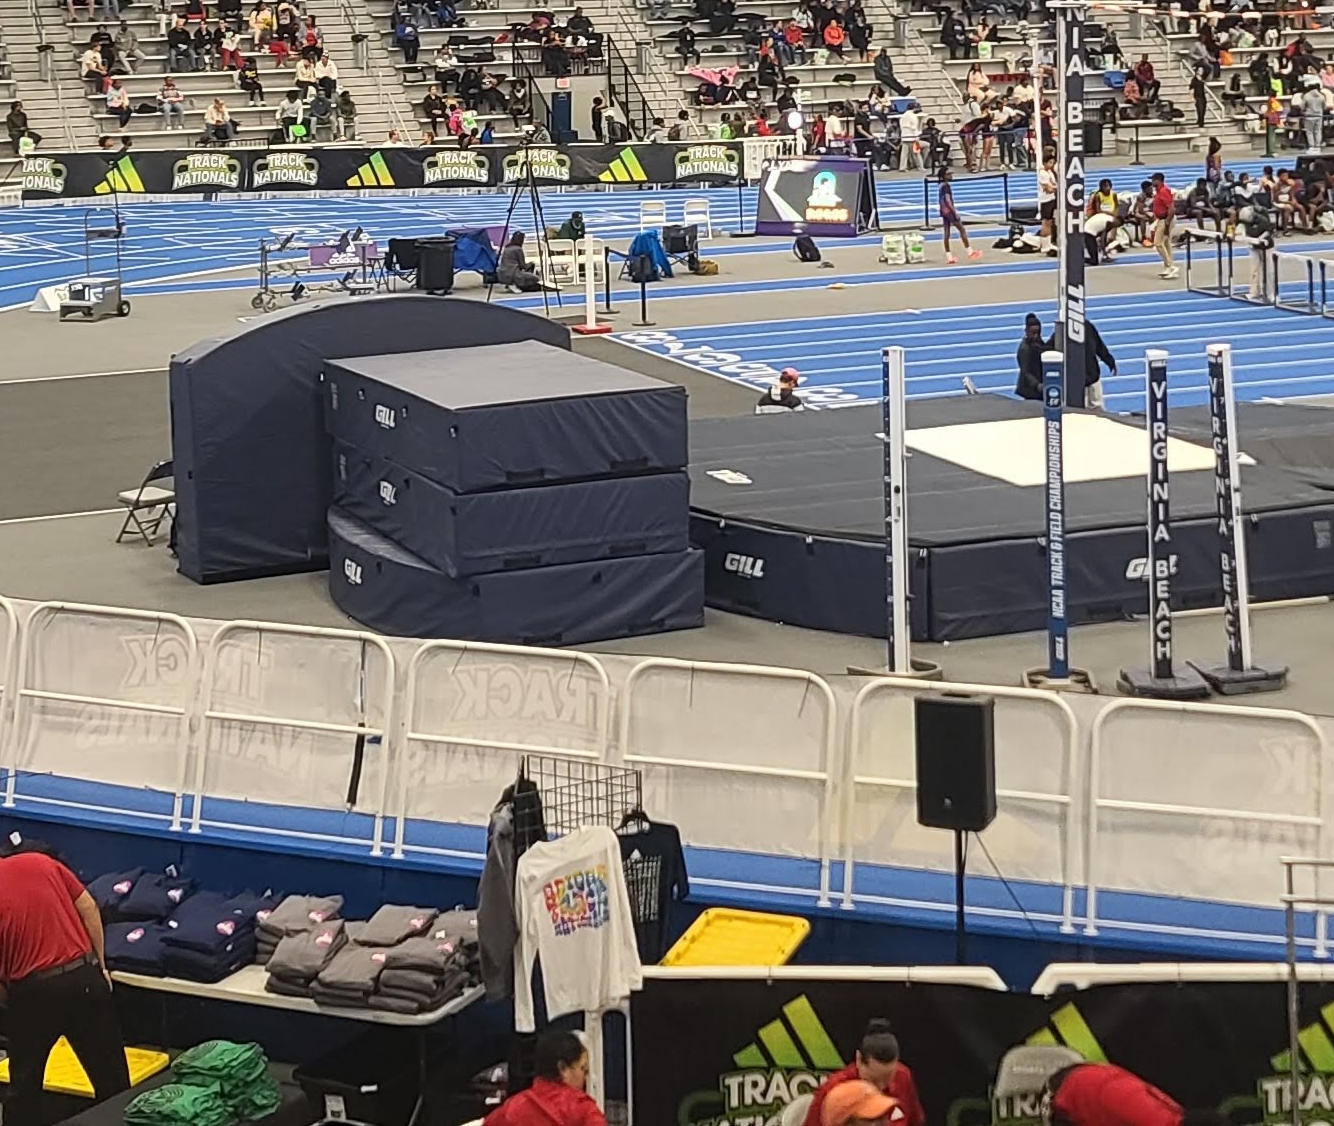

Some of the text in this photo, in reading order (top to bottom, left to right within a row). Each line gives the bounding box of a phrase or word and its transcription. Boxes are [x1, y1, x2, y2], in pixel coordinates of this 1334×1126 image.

[186, 153, 228, 169] TRACK
[266, 152, 307, 167] TRACK
[436, 150, 476, 165] TRACK
[687, 145, 728, 161] TRACK
[22, 158, 54, 173] RACK
[424, 167, 489, 185] NATIONALS
[675, 161, 738, 178] NATIONALS
[1066, 101, 1085, 234] BEACH
[22, 174, 64, 192] IONALS
[172, 171, 240, 190] NATIONALS
[252, 170, 318, 188] NATIONALS
[1067, 284, 1085, 344] GILL
[375, 404, 396, 428] GILL
[1048, 420, 1062, 511] CHAMPIONSHIPS
[380, 481, 397, 504] GILL
[1049, 511, 1063, 541] FIELD
[1151, 381, 1171, 660] VIRGINIA BEACH
[1209, 377, 1229, 536] VIRGINIA
[1220, 552, 1236, 653] BEACH
[344, 558, 362, 585] GILL
[724, 552, 764, 578] GILL
[1050, 551, 1064, 586] TRACK
[1051, 589, 1064, 618] NCAA
[725, 1071, 828, 1108] TRAC
